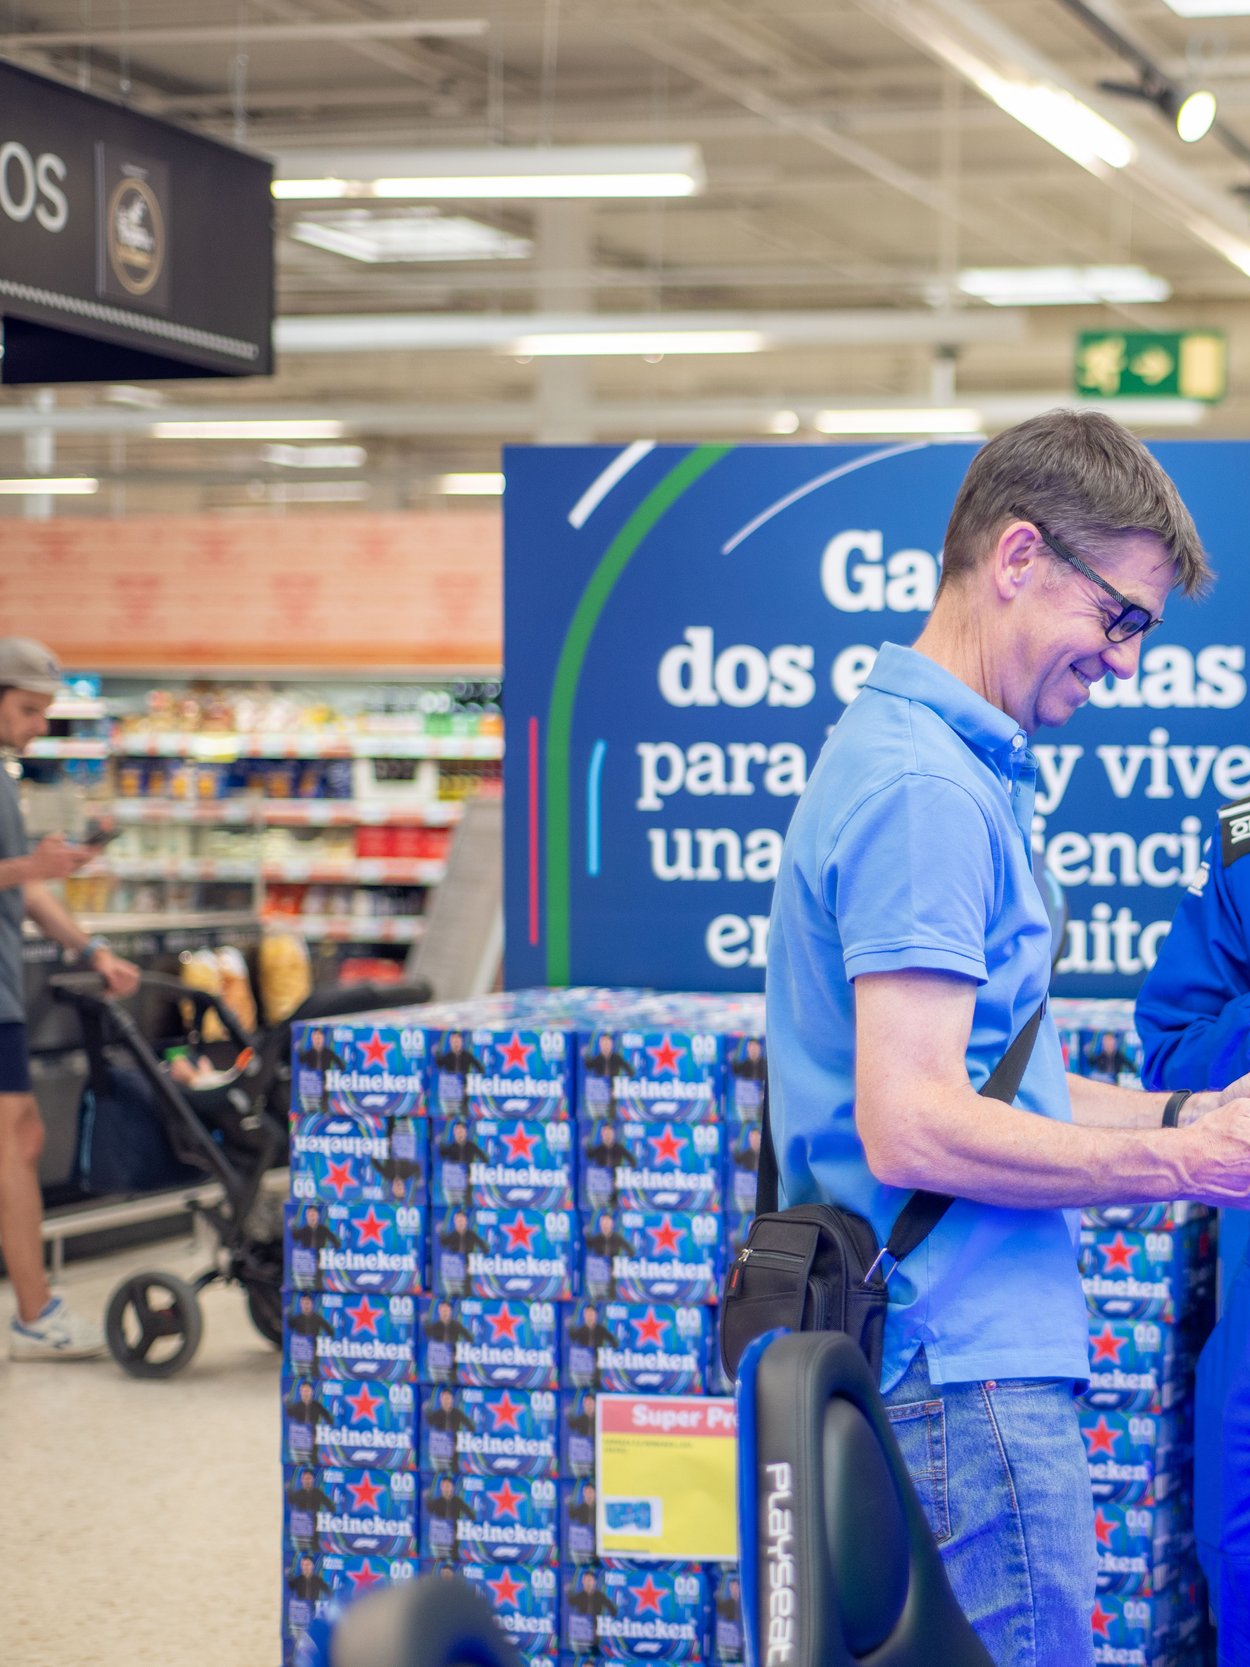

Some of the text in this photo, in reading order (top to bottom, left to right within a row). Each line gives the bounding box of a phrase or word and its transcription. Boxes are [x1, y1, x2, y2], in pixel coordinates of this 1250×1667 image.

[821, 530, 938, 613] Ga
[657, 626, 816, 708] dos
[636, 742, 808, 811] para
[1033, 744, 1083, 815] y
[647, 828, 785, 882] una
[325, 1069, 422, 1093] Heineken
[467, 1074, 563, 1098] Heineken
[613, 1076, 712, 1100] Heineken
[470, 1163, 567, 1187] Heineken
[616, 1167, 714, 1190] Heineken
[319, 1248, 416, 1271] Heineken
[468, 1253, 565, 1277] Heineken
[613, 1257, 711, 1280] Heineken
[1082, 1276, 1171, 1298] eineken
[316, 1337, 412, 1360] Heineken
[456, 1343, 552, 1367] Heineken
[598, 1348, 697, 1371] Heineken
[1090, 1370, 1156, 1389] neken
[632, 1404, 736, 1431] Super Pr
[316, 1424, 411, 1448] Heineken
[456, 1432, 553, 1455] Heineken
[1088, 1461, 1149, 1479] neken
[317, 1513, 413, 1536] Heineken
[457, 1520, 553, 1545] Heineken
[1098, 1553, 1147, 1571] eken
[502, 1611, 553, 1635] eken
[596, 1615, 696, 1640] Heineken
[1096, 1645, 1146, 1664] eken
